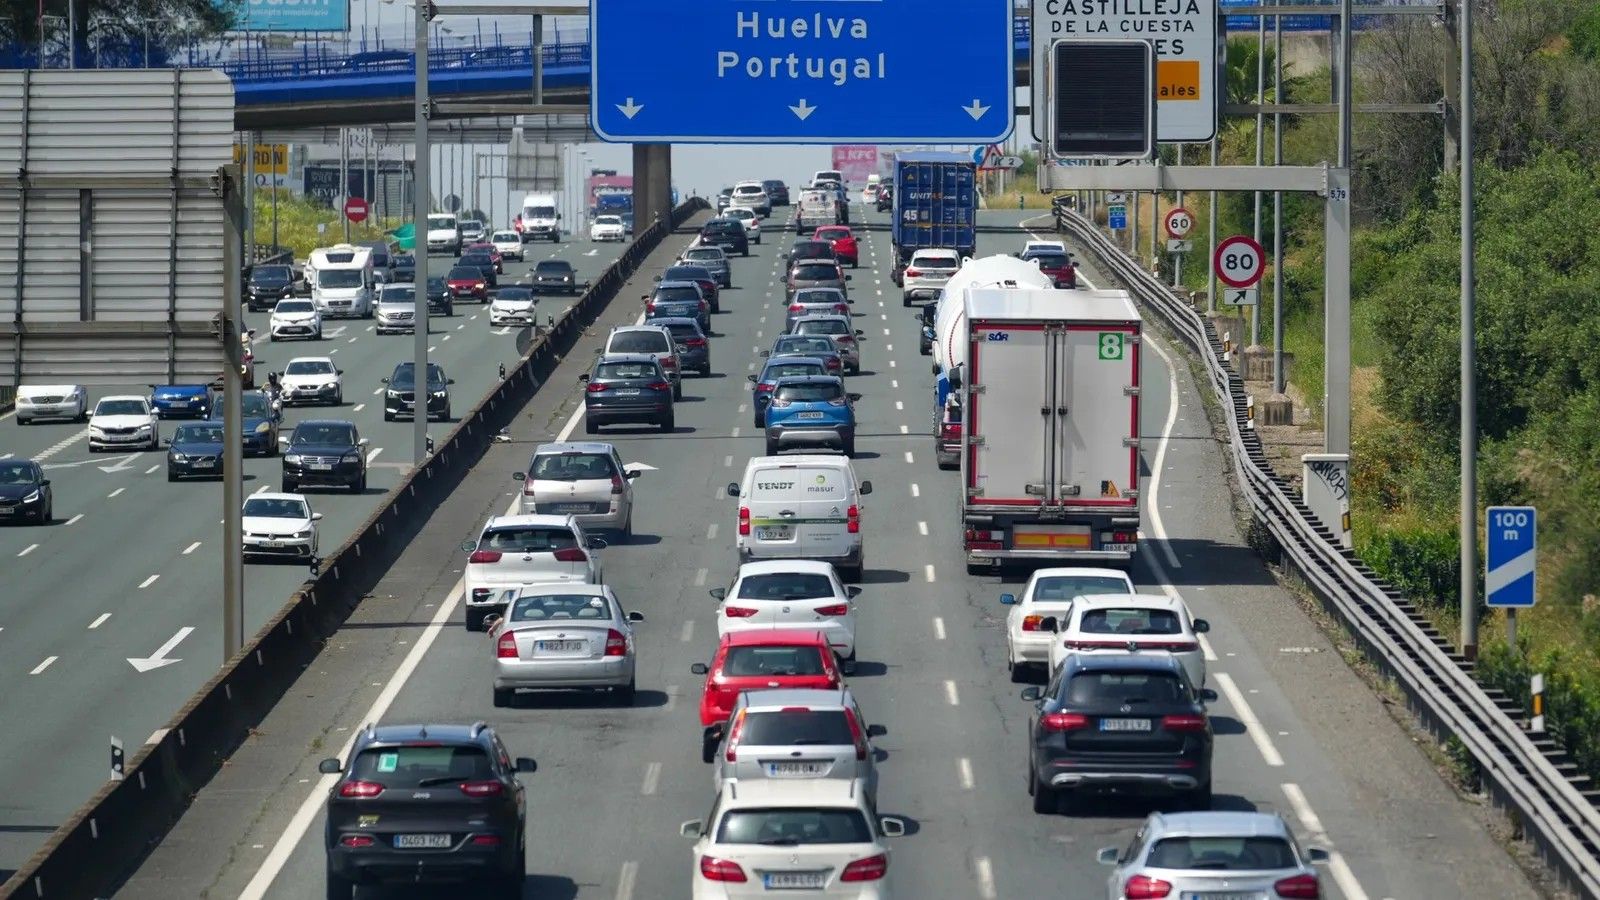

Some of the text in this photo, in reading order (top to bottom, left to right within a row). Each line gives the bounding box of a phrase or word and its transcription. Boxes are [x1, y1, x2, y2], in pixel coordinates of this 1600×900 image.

[1046, 0, 1200, 15] CASTILLEJA
[737, 12, 867, 38] Huelva
[1052, 20, 1195, 32] DE LA CUESTA
[1155, 39, 1184, 55] ES
[718, 52, 885, 85] Portugal
[1160, 84, 1196, 96] ales
[233, 152, 283, 165] JRDN
[903, 210, 917, 220] 45
[1171, 218, 1188, 229] 60
[1225, 253, 1254, 270] 80
[1101, 335, 1120, 359] 8
[758, 482, 795, 490] FENDT
[1495, 513, 1527, 527] 100
[1503, 530, 1518, 540] m
